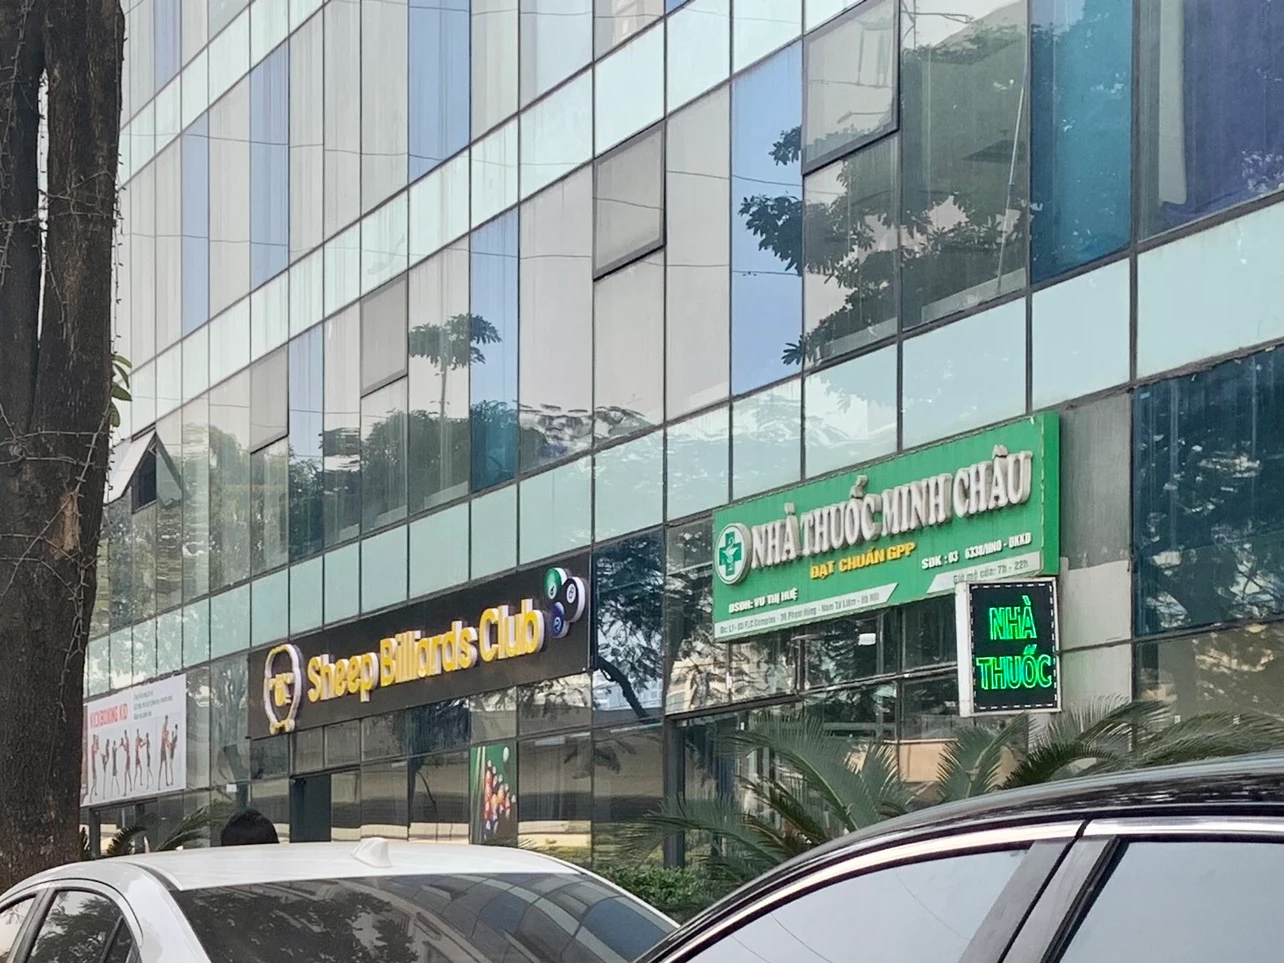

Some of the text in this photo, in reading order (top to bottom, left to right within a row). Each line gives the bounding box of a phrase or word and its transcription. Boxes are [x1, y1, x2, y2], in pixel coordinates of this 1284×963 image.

[751, 445, 1034, 569] NHÀ THUỐC MINH CHÂU
[810, 561, 835, 580] ĐẠT
[886, 542, 917, 562] GPP
[989, 594, 1037, 641] NHÀ
[307, 598, 545, 703] Sheep Billiards Club
[976, 644, 1053, 691] THUỐC
